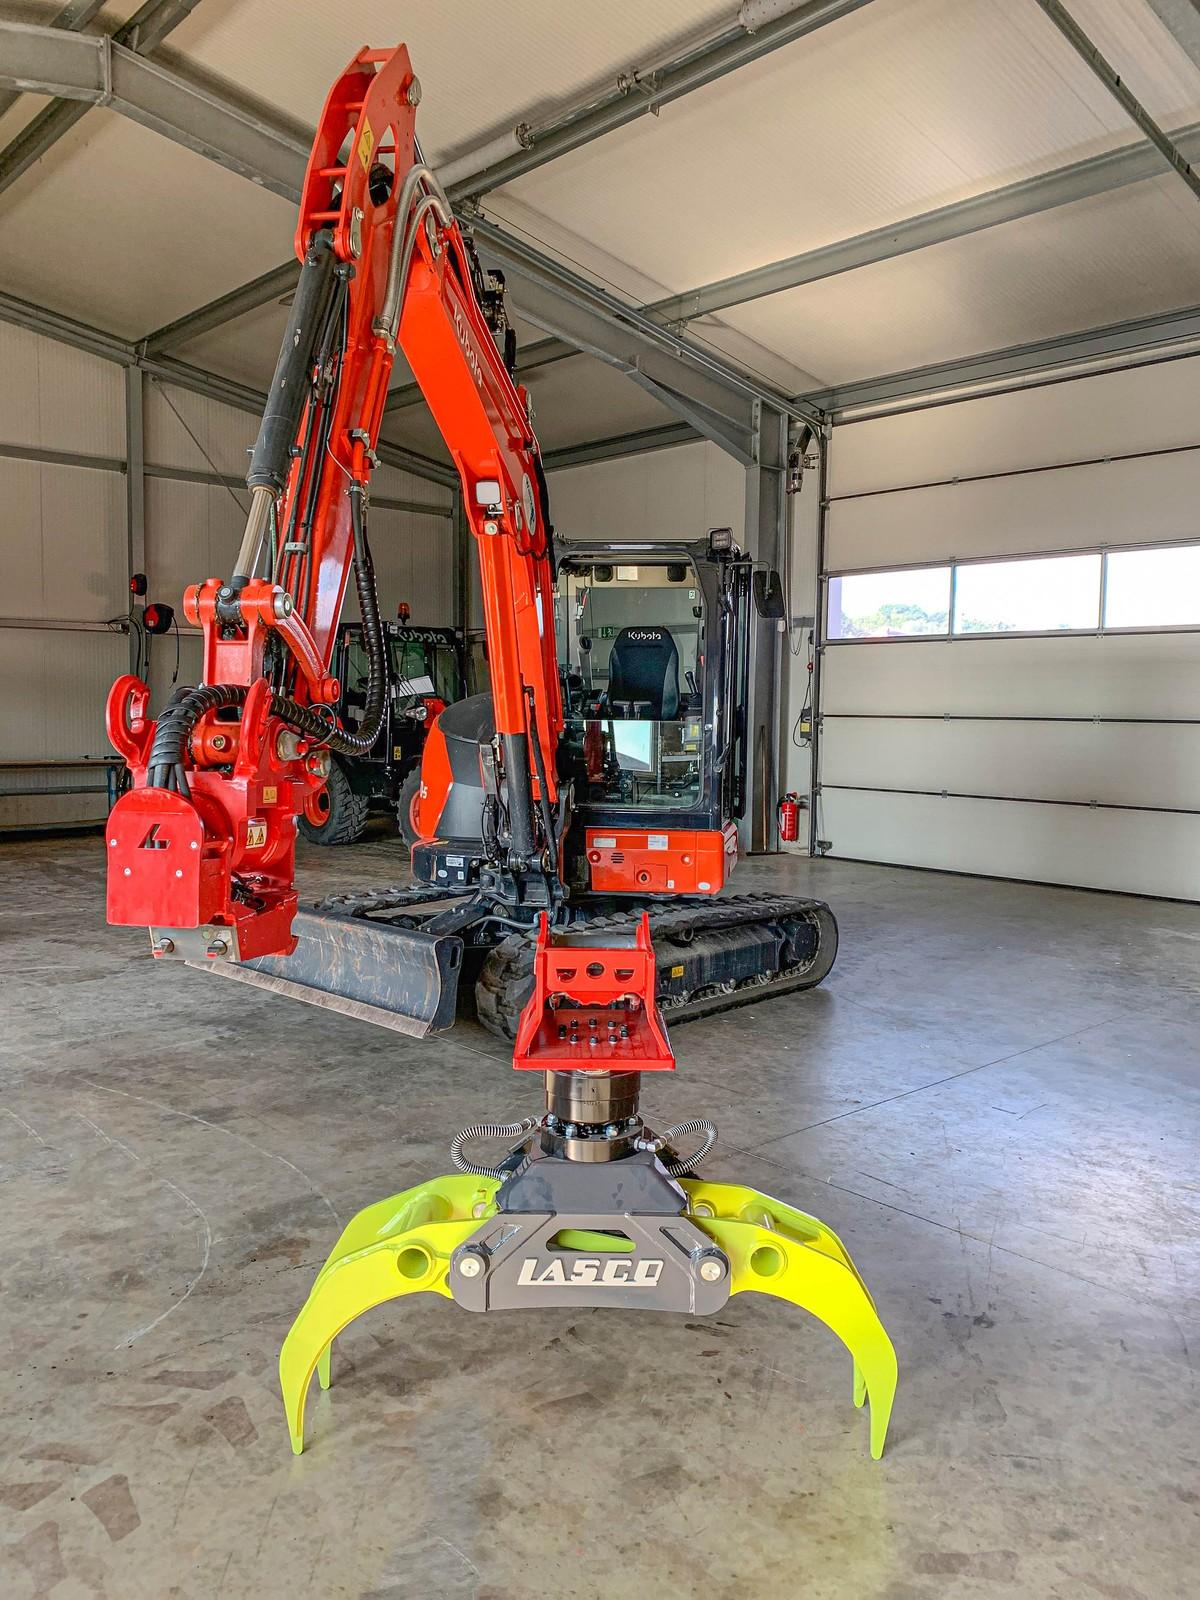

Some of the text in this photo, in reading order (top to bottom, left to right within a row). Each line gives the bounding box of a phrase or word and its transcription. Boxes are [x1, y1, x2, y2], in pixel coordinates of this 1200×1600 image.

[453, 303, 483, 388] Kubota
[627, 631, 662, 640] Kubota
[517, 1257, 664, 1286] LASCO
